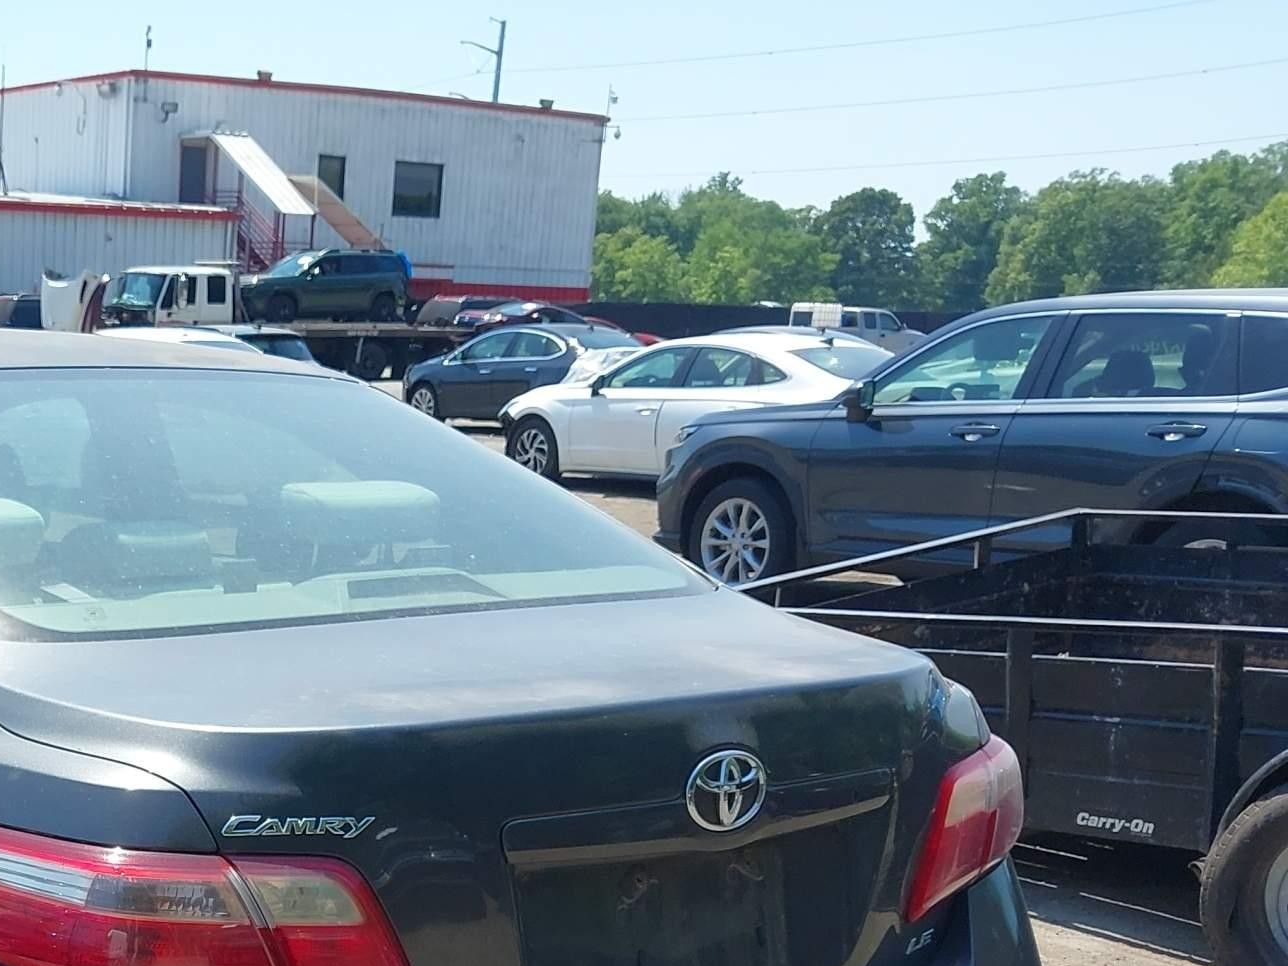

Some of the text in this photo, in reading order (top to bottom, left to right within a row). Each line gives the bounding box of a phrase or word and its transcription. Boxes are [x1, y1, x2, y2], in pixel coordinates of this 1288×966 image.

[221, 814, 376, 839] CAMRY
[1076, 812, 1155, 834] Carry-On
[905, 928, 935, 955] LE
